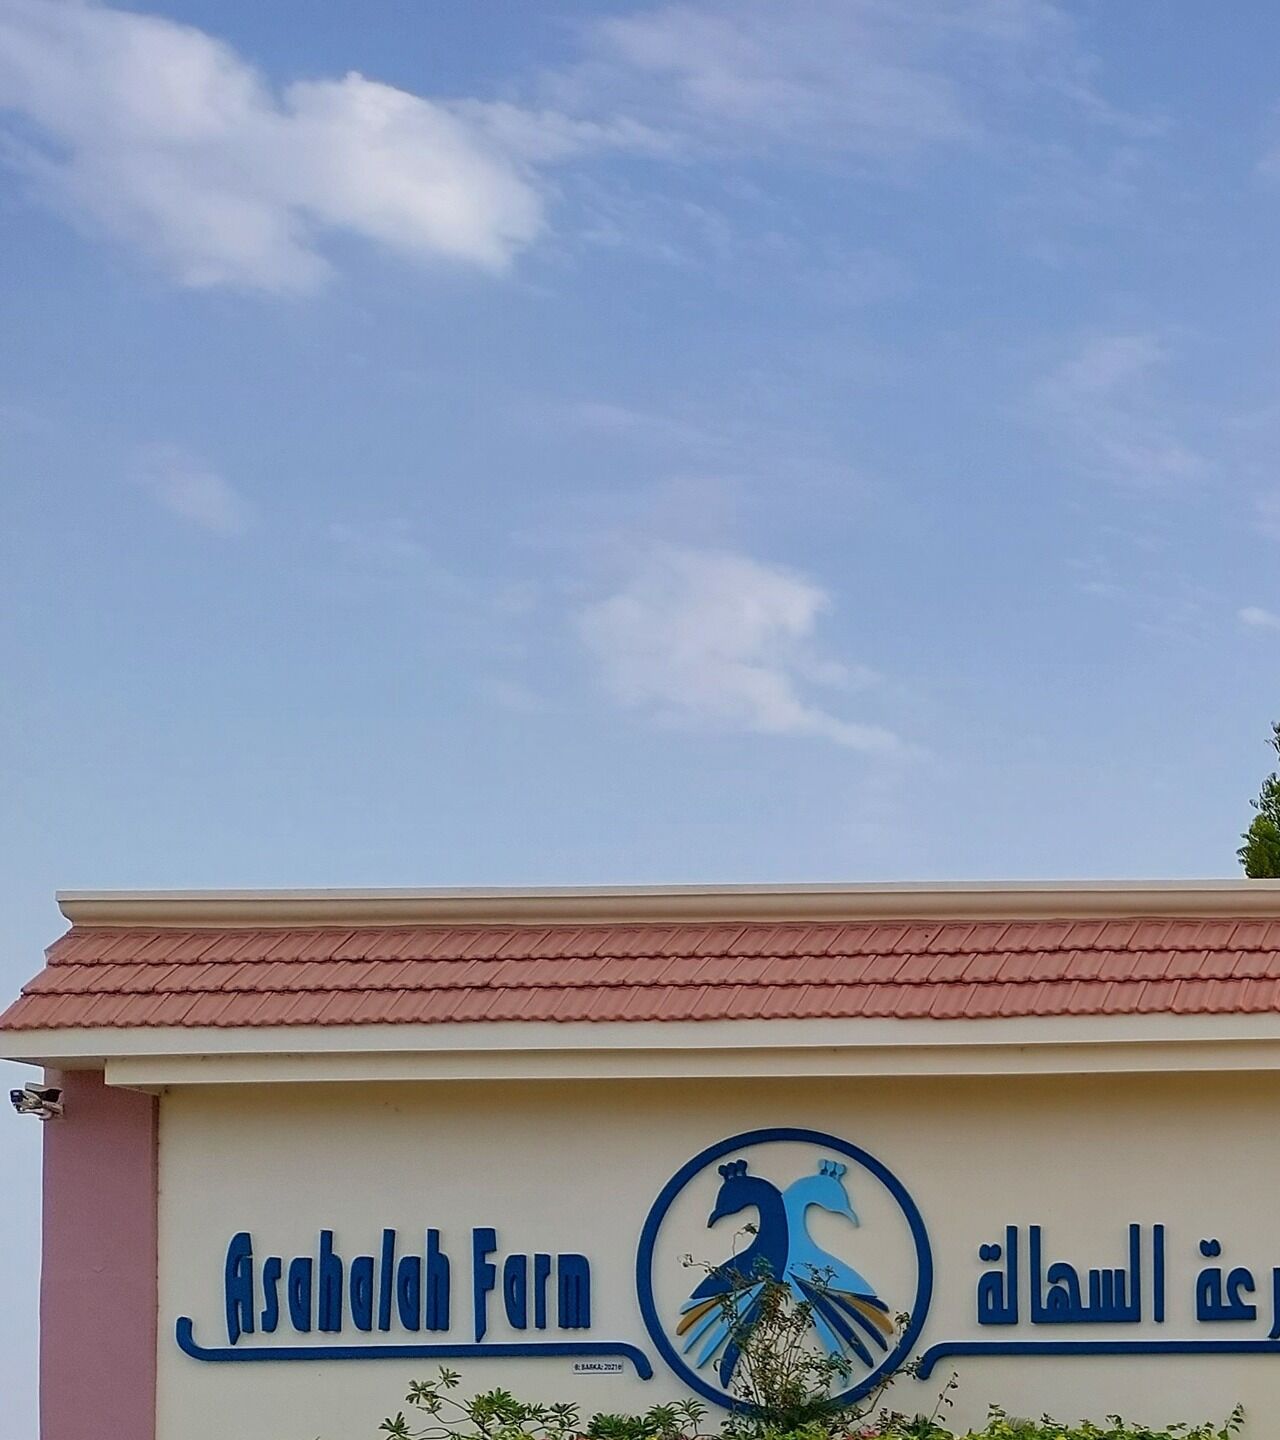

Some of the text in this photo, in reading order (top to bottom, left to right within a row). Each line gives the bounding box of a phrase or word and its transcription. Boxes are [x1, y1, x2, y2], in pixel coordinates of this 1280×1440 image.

[225, 1226, 592, 1345] Asahalah Farm
[977, 1222, 1165, 1325] السهالة
